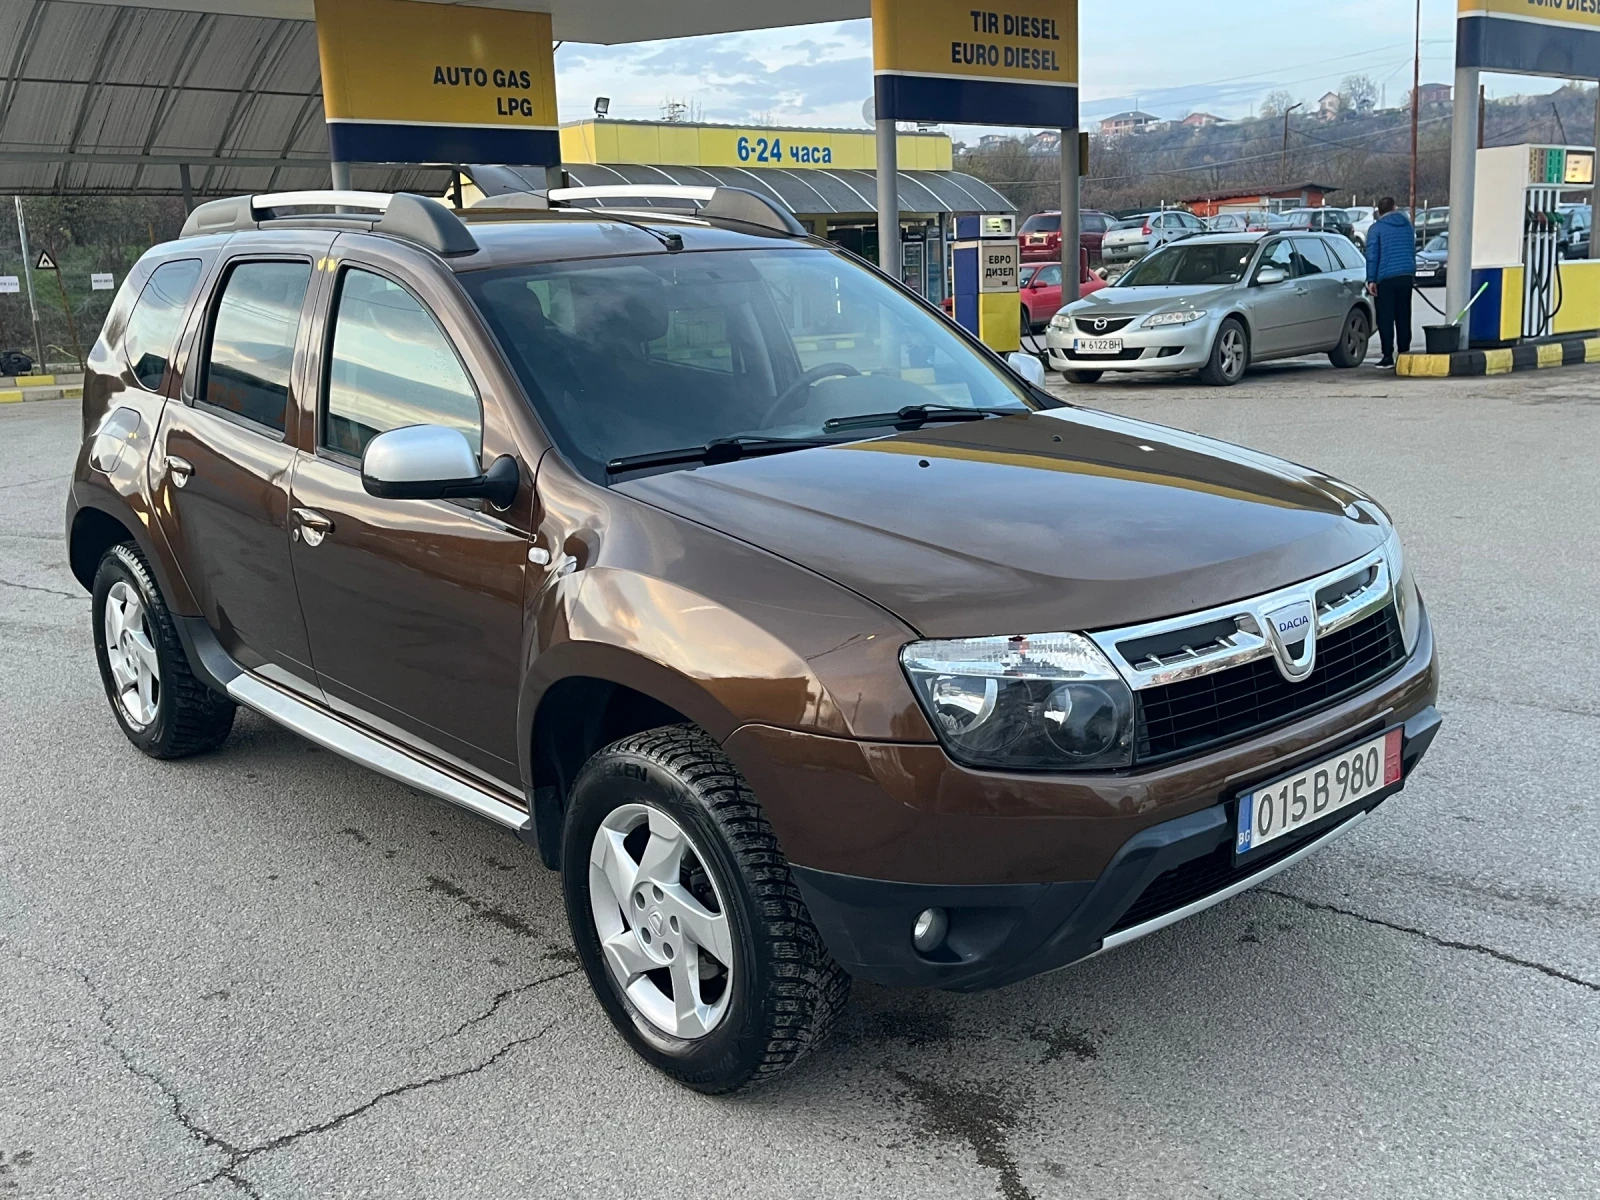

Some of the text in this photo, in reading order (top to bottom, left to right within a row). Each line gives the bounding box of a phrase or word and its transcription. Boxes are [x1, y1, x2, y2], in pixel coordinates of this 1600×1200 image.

[970, 10, 1060, 40] TIR DIESEL
[951, 41, 1060, 71] EURO DIESEL
[433, 66, 531, 90] AUTO GAS
[497, 97, 532, 117] LPG
[737, 136, 832, 164] 6-24 часа
[988, 255, 1012, 265] ЕВРО
[985, 267, 1015, 279] ДИЗЕЛ
[1279, 615, 1309, 632] DACIA
[1238, 829, 1250, 846] BG
